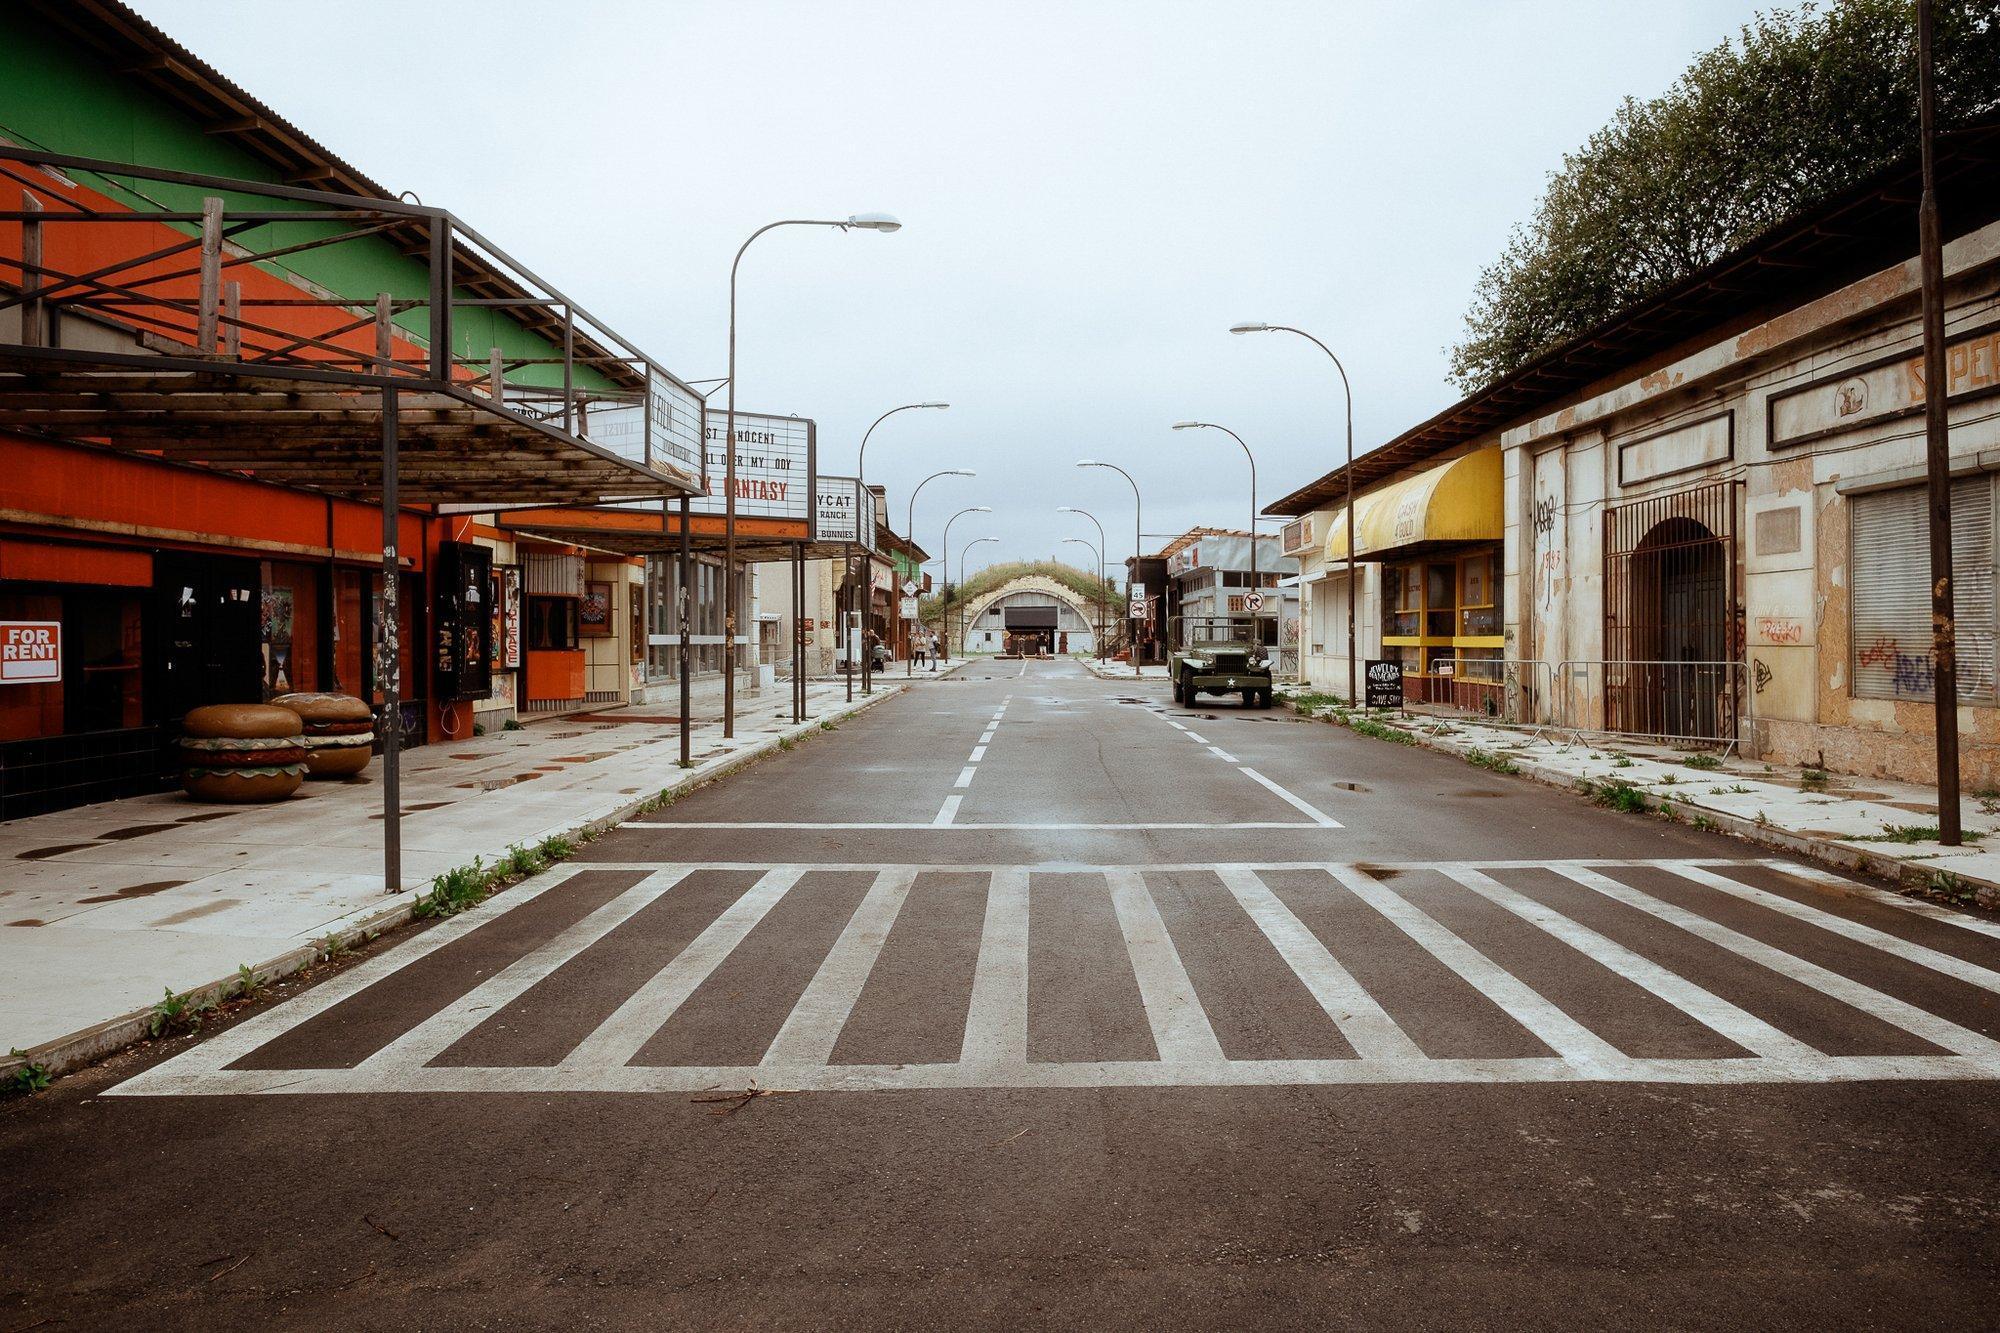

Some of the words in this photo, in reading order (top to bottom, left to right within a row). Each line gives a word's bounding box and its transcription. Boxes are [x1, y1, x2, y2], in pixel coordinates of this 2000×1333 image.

[1906, 332, 2000, 402] SPE
[705, 428, 718, 440] ST
[737, 430, 775, 445] NOCENT
[706, 452, 716, 465] LL
[721, 453, 743, 467] OER
[751, 456, 764, 468] MY
[775, 458, 792, 470] ODY
[820, 511, 847, 519] RANCH
[821, 530, 854, 539] BUNNIES
[8, 629, 50, 645] FOR
[3, 644, 56, 660] RENT
